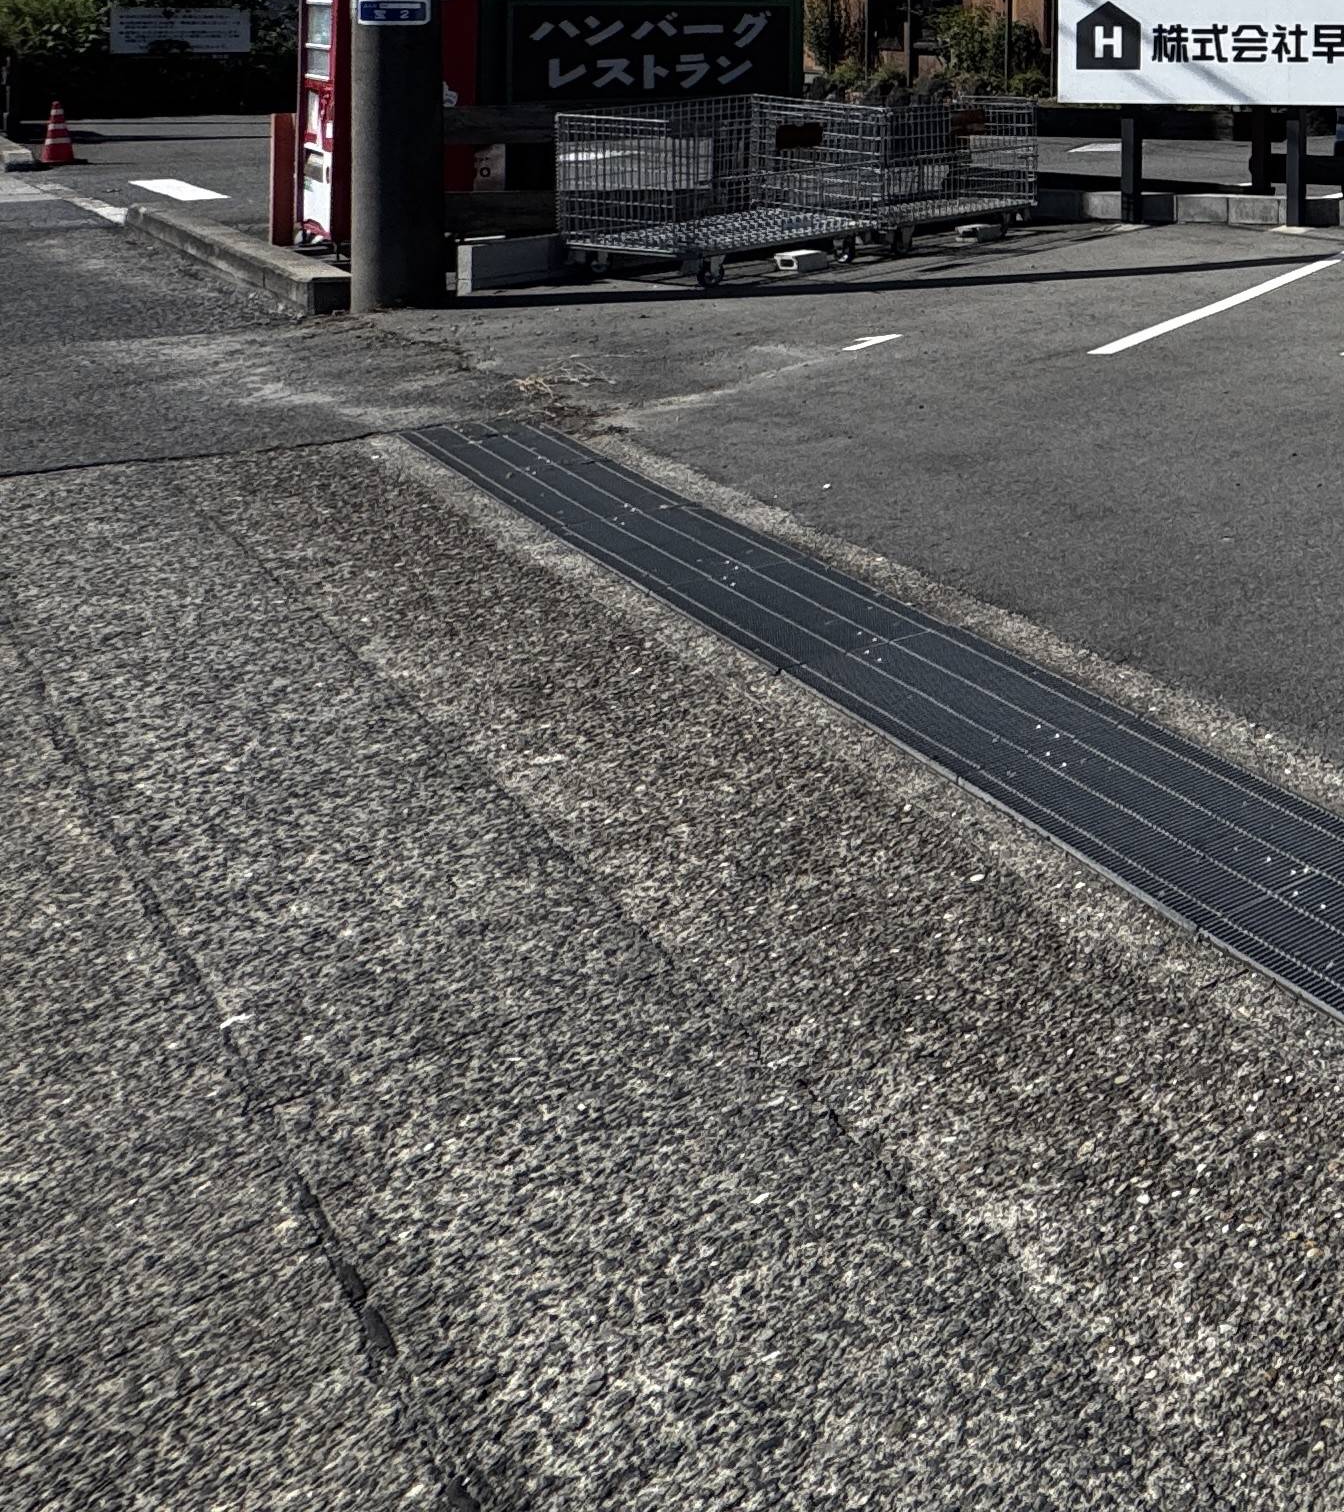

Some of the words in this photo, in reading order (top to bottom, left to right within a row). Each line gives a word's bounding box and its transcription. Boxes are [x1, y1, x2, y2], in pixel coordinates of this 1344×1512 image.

[529, 11, 772, 48] ハンバーグ
[1094, 25, 1122, 58] H
[548, 53, 753, 88] レストラン
[842, 334, 902, 351] 1
